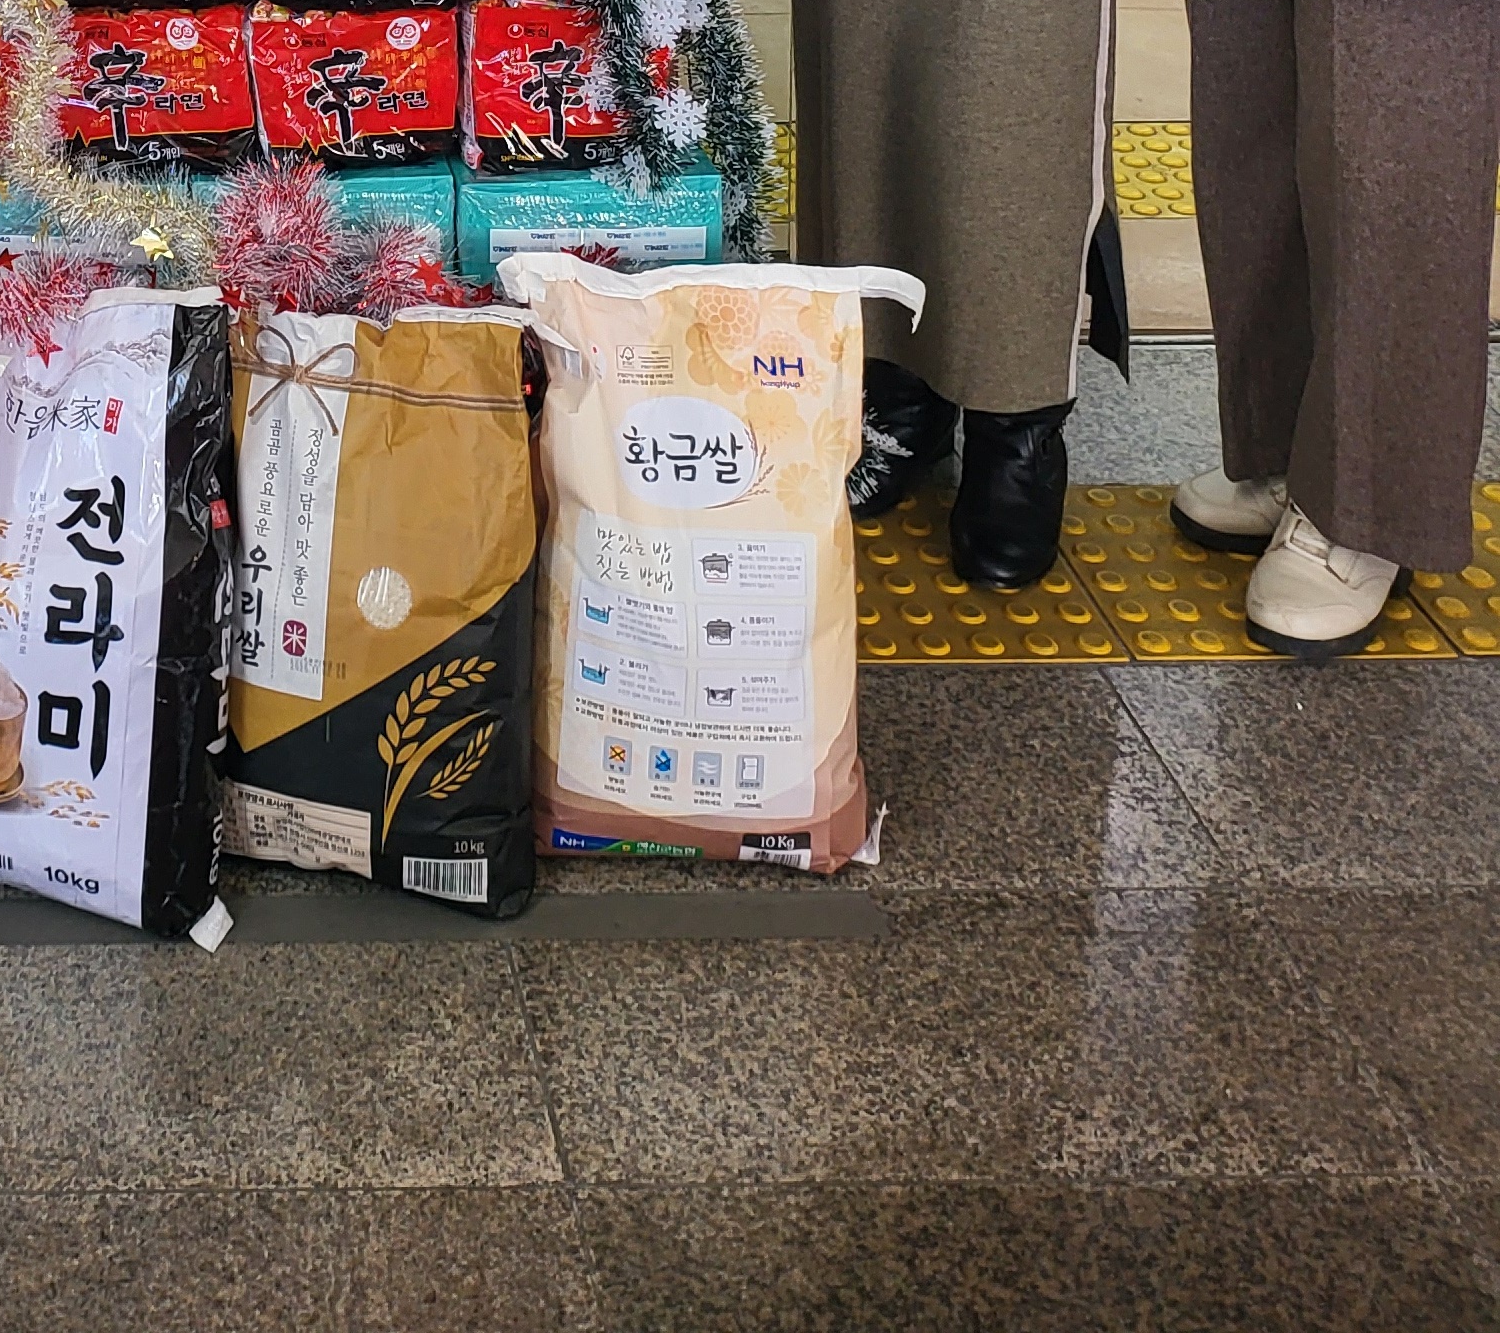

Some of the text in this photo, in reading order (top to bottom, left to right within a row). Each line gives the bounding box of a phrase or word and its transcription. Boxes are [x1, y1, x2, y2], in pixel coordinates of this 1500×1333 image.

[83, 42, 205, 151] 辛 라면
[304, 48, 428, 155] 辛 라면
[520, 39, 590, 148] 辛
[753, 355, 804, 378] NH
[106, 401, 121, 432] 미가
[623, 425, 744, 484] 황금쌀
[292, 429, 324, 607] 정성을 담아 맛 좋은
[235, 419, 283, 668] 곰곰 풍요로운 우리쌀
[597, 527, 673, 566] 맛있는 밥
[596, 554, 674, 594] 짓는 방법
[38, 475, 126, 781] 전라미
[454, 839, 485, 854] 10 kg
[559, 835, 586, 848] NH
[761, 835, 795, 850] 10 Kg
[44, 865, 99, 895] 10kg
